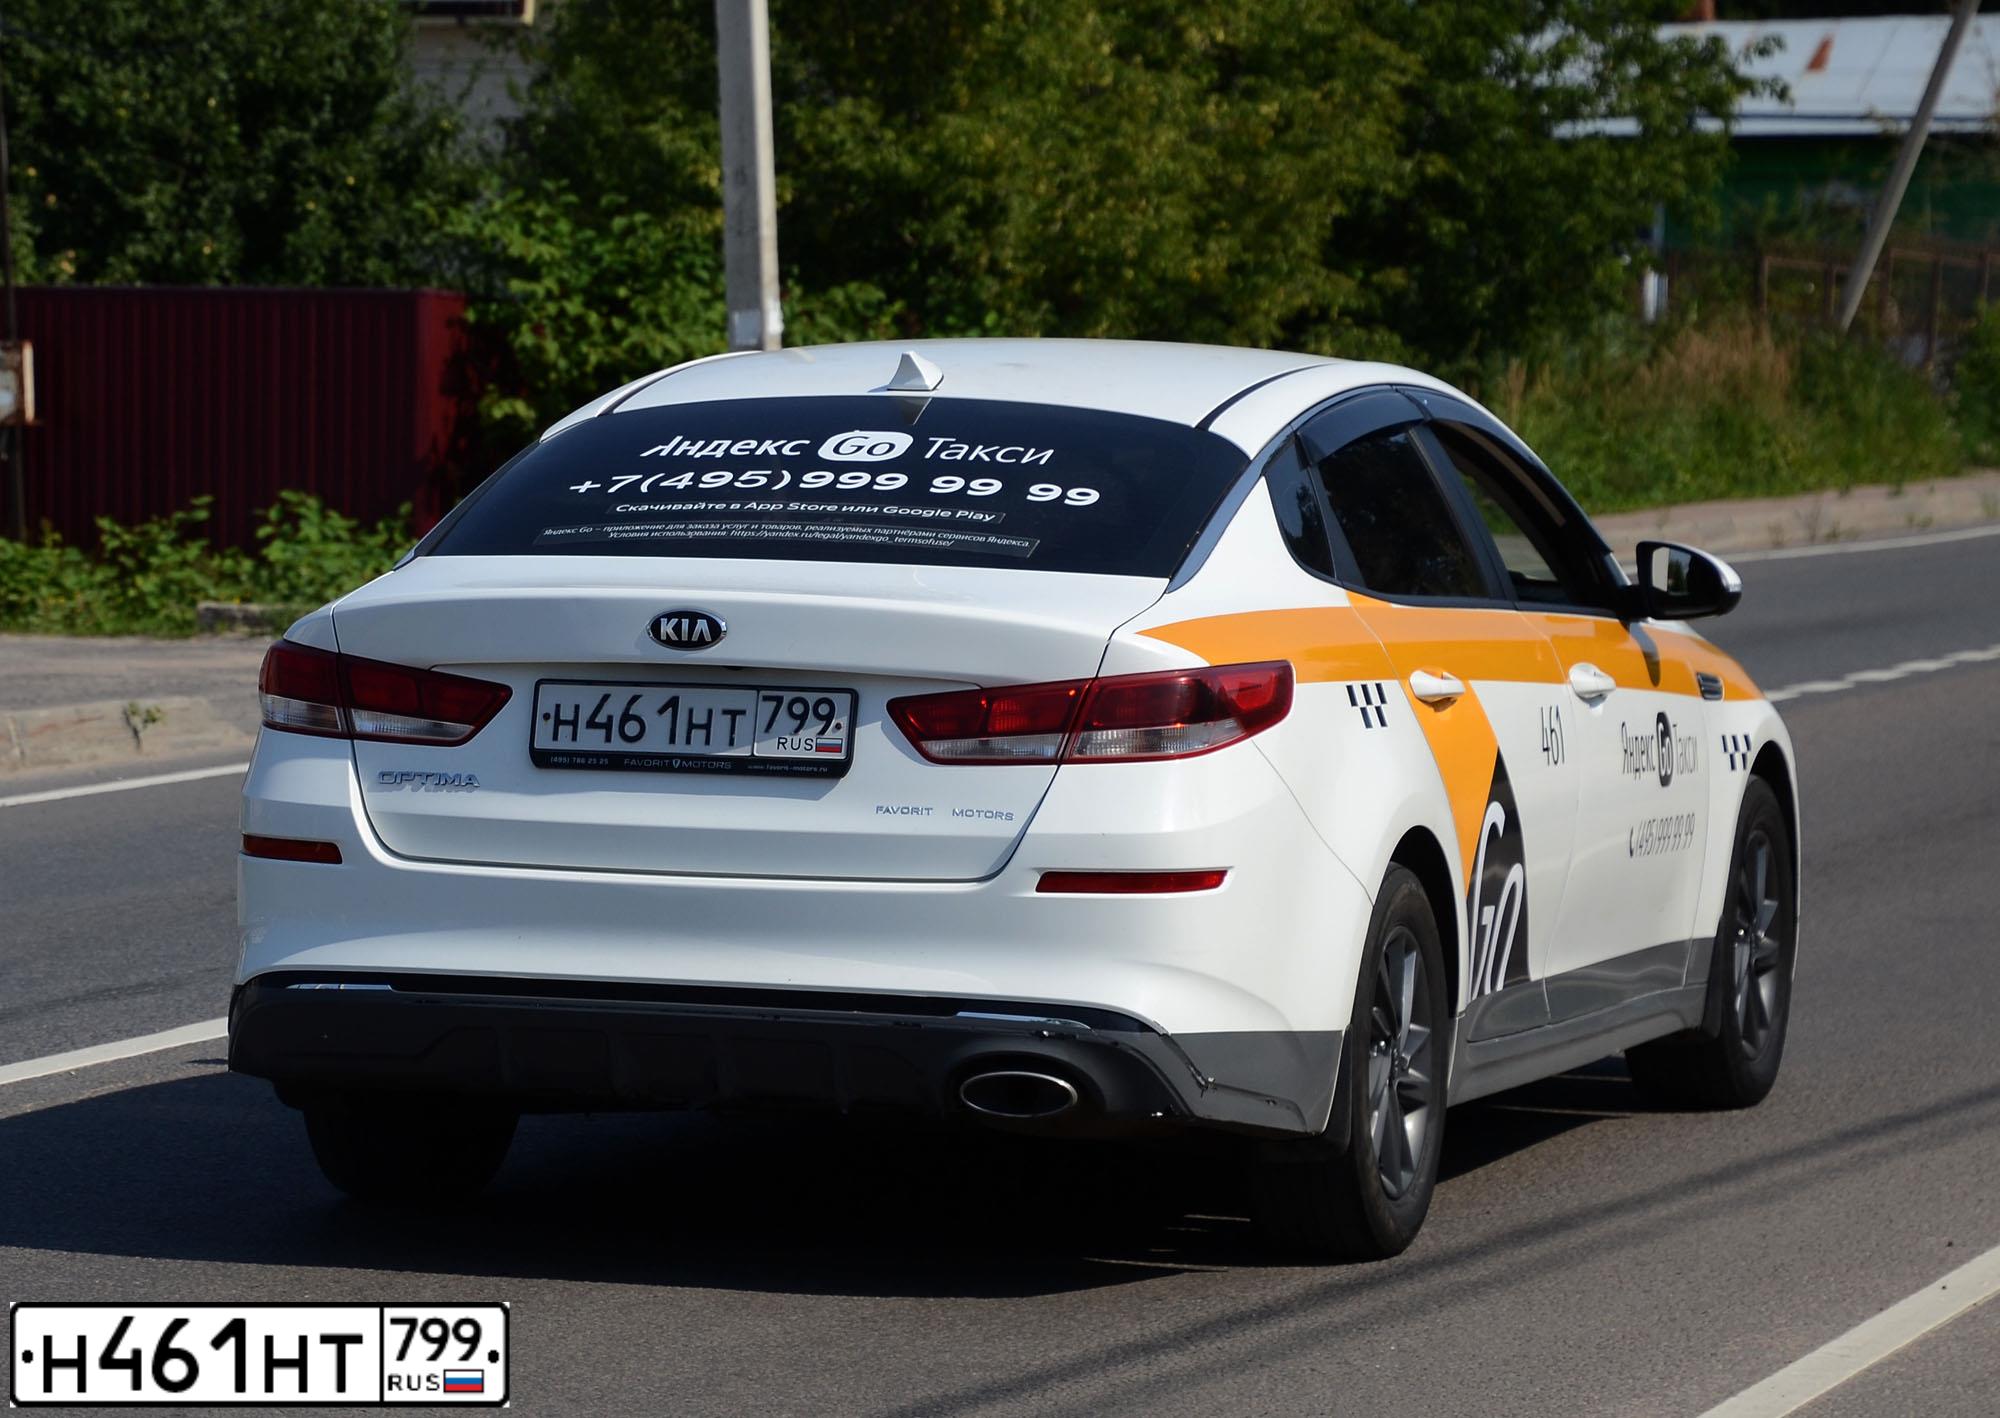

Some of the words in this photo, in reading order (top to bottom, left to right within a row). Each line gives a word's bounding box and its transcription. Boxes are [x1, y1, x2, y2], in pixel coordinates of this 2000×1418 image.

[639, 435, 811, 459] Яндекс
[832, 435, 896, 457] Go
[924, 437, 1055, 465] Такси
[929, 476, 1003, 496] 99
[1026, 483, 1100, 506] 99
[615, 501, 727, 512] Скачивайте
[729, 502, 741, 510] в
[744, 502, 784, 512] App
[787, 502, 838, 512] Store
[882, 505, 952, 518] Google
[955, 509, 996, 523] Play
[579, 526, 593, 534] Go
[602, 523, 664, 533] приложение
[665, 523, 685, 531] для
[686, 522, 720, 530] заказа
[937, 531, 986, 543] сервисов
[608, 530, 649, 539] Условия
[660, 617, 712, 641] KIA
[761, 694, 837, 736] 799
[776, 736, 814, 751] RUS
[1540, 704, 1565, 766] 461
[1620, 720, 1655, 780] Яндекс
[624, 758, 670, 767] FAVORIT
[682, 759, 732, 769] MOTORS
[378, 770, 481, 788] OPTIMA
[875, 805, 934, 816] FAVORIT
[952, 808, 1015, 822] MOTORS
